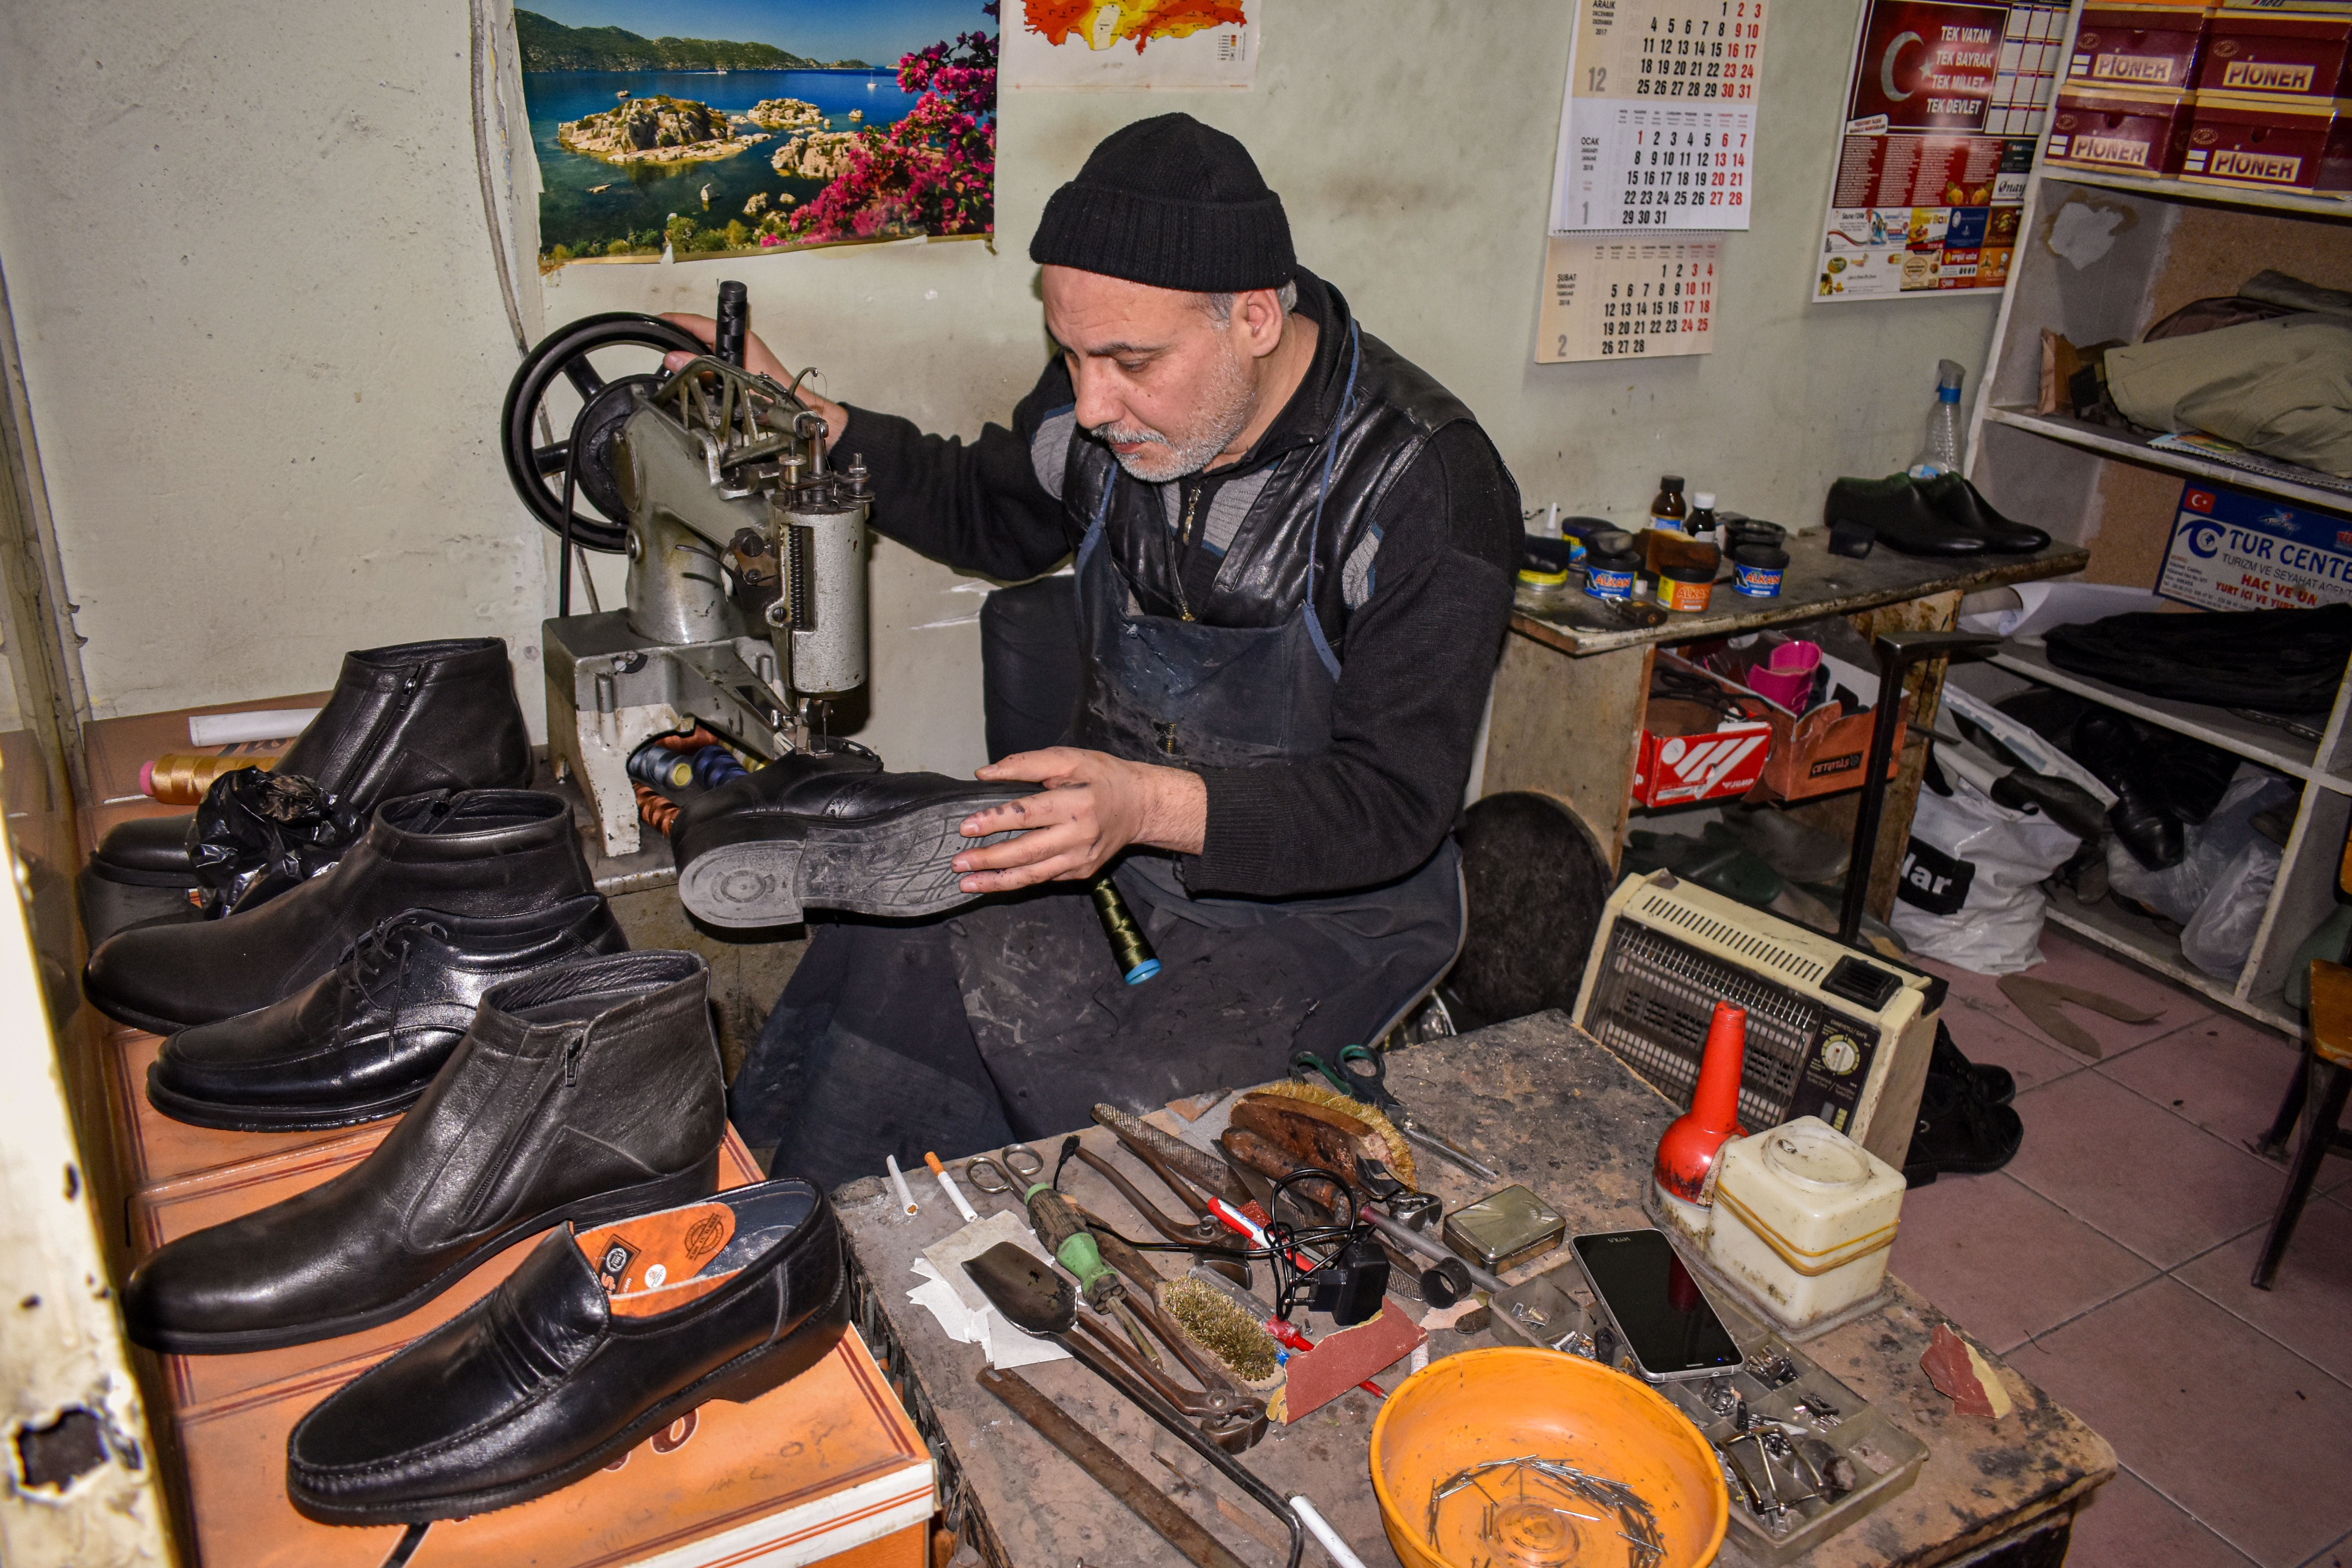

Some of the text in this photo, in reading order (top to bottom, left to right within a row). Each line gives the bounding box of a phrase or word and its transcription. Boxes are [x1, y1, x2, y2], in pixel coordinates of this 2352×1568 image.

[1592, 0, 1615, 9] ARALIK
[1723, 1, 1761, 18] 1 2 3
[1651, 17, 1759, 38] 4 5 6 7 8 9 10
[1942, 25, 1991, 44] TEK VATAN
[1644, 37, 1757, 58] 11 12 13 14 15 16 17
[1937, 50, 1993, 68] TEK BAYRAK
[1641, 58, 1754, 78] 18 19 20 21 22 23 24
[1588, 67, 1607, 92] 12
[1933, 74, 1950, 89] TEK
[1637, 79, 1751, 98] 25 26 27 28 29 30 31
[1927, 98, 1982, 114] TEK DEVLET
[1581, 137, 1599, 145] OCAK
[1639, 130, 1747, 147] 1 2 3 4 5 6 7
[1635, 151, 1745, 167] 8 9 10 11 12 13 14
[1628, 171, 1742, 186] 15 16 17 18 19 20 21
[1624, 191, 1742, 205] 22 23 24 25 26 27 28
[1582, 201, 1589, 225] 1
[1622, 210, 1666, 224] 29 30 31
[1557, 273, 1577, 282] ŞUBAT
[1662, 263, 1713, 278] 1 2 3 4
[1611, 281, 1711, 298] 5 6 7 8 9 10 11
[1605, 300, 1710, 317] 12 13 14 15 16 17 18
[1604, 318, 1708, 336] 19 20 21 22 23 24 25
[1557, 334, 1567, 356] 2
[1602, 339, 1644, 354] 26 27 28
[2229, 529, 2274, 559] TUR
[1746, 572, 1782, 584] ALKAN
[2223, 553, 2257, 571] TURİZM
[2260, 564, 2272, 575] VE
[2274, 569, 2318, 588] SEYAHAT
[1595, 574, 1632, 588] ALKAN
[2241, 574, 2270, 592] HAC
[2276, 583, 2295, 599] VE
[1677, 587, 1711, 599] ALKAN
[2216, 581, 2239, 595] YURT
[2256, 593, 2268, 604] VE
[1856, 1029, 1868, 1039] SAFE
[612, 1252, 623, 1267] 1981
